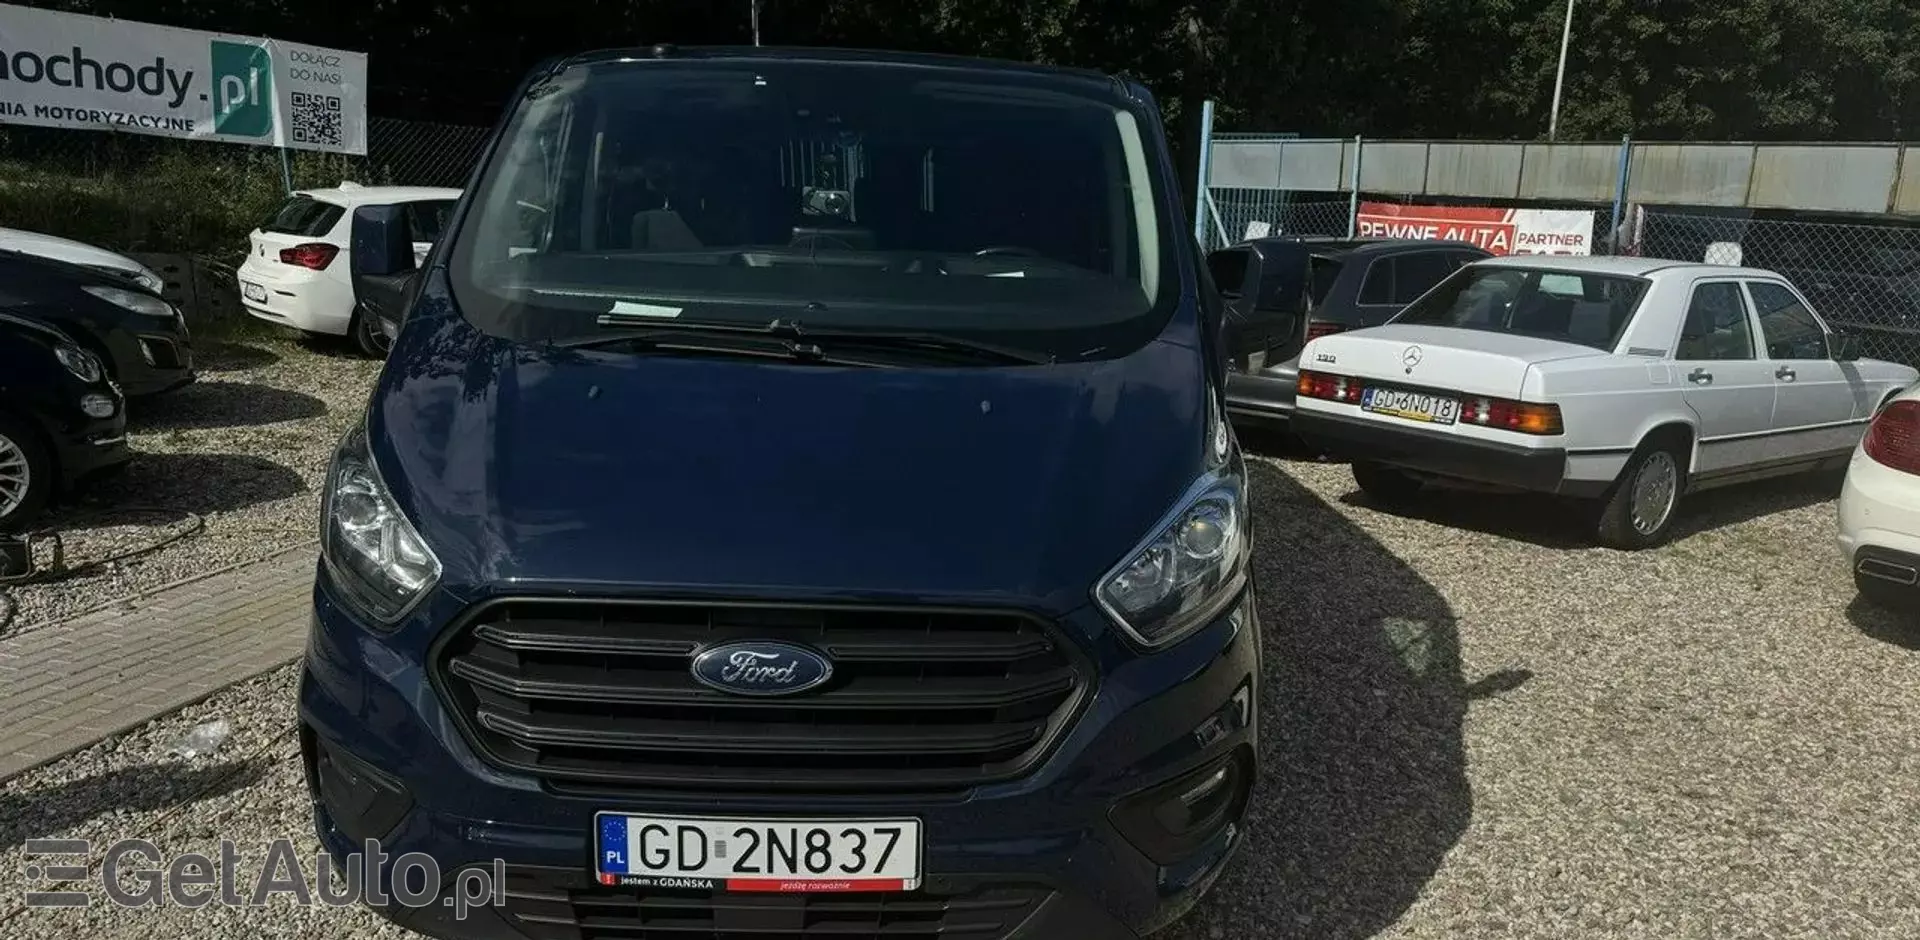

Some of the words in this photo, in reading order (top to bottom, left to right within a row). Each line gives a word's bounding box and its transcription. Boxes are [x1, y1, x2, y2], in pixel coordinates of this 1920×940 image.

[290, 68, 310, 80] DO
[34, 104, 195, 132] MOTORYZACYJNE
[1518, 232, 1584, 246] PARTNER
[1374, 388, 1396, 408] GD
[1400, 391, 1452, 417] 6N018
[721, 650, 799, 683] Ford
[606, 851, 625, 864] PL
[639, 823, 708, 872] GD
[732, 826, 902, 874] 2N837
[620, 877, 651, 886] jestem
[659, 876, 714, 889] GDAŃSKA
